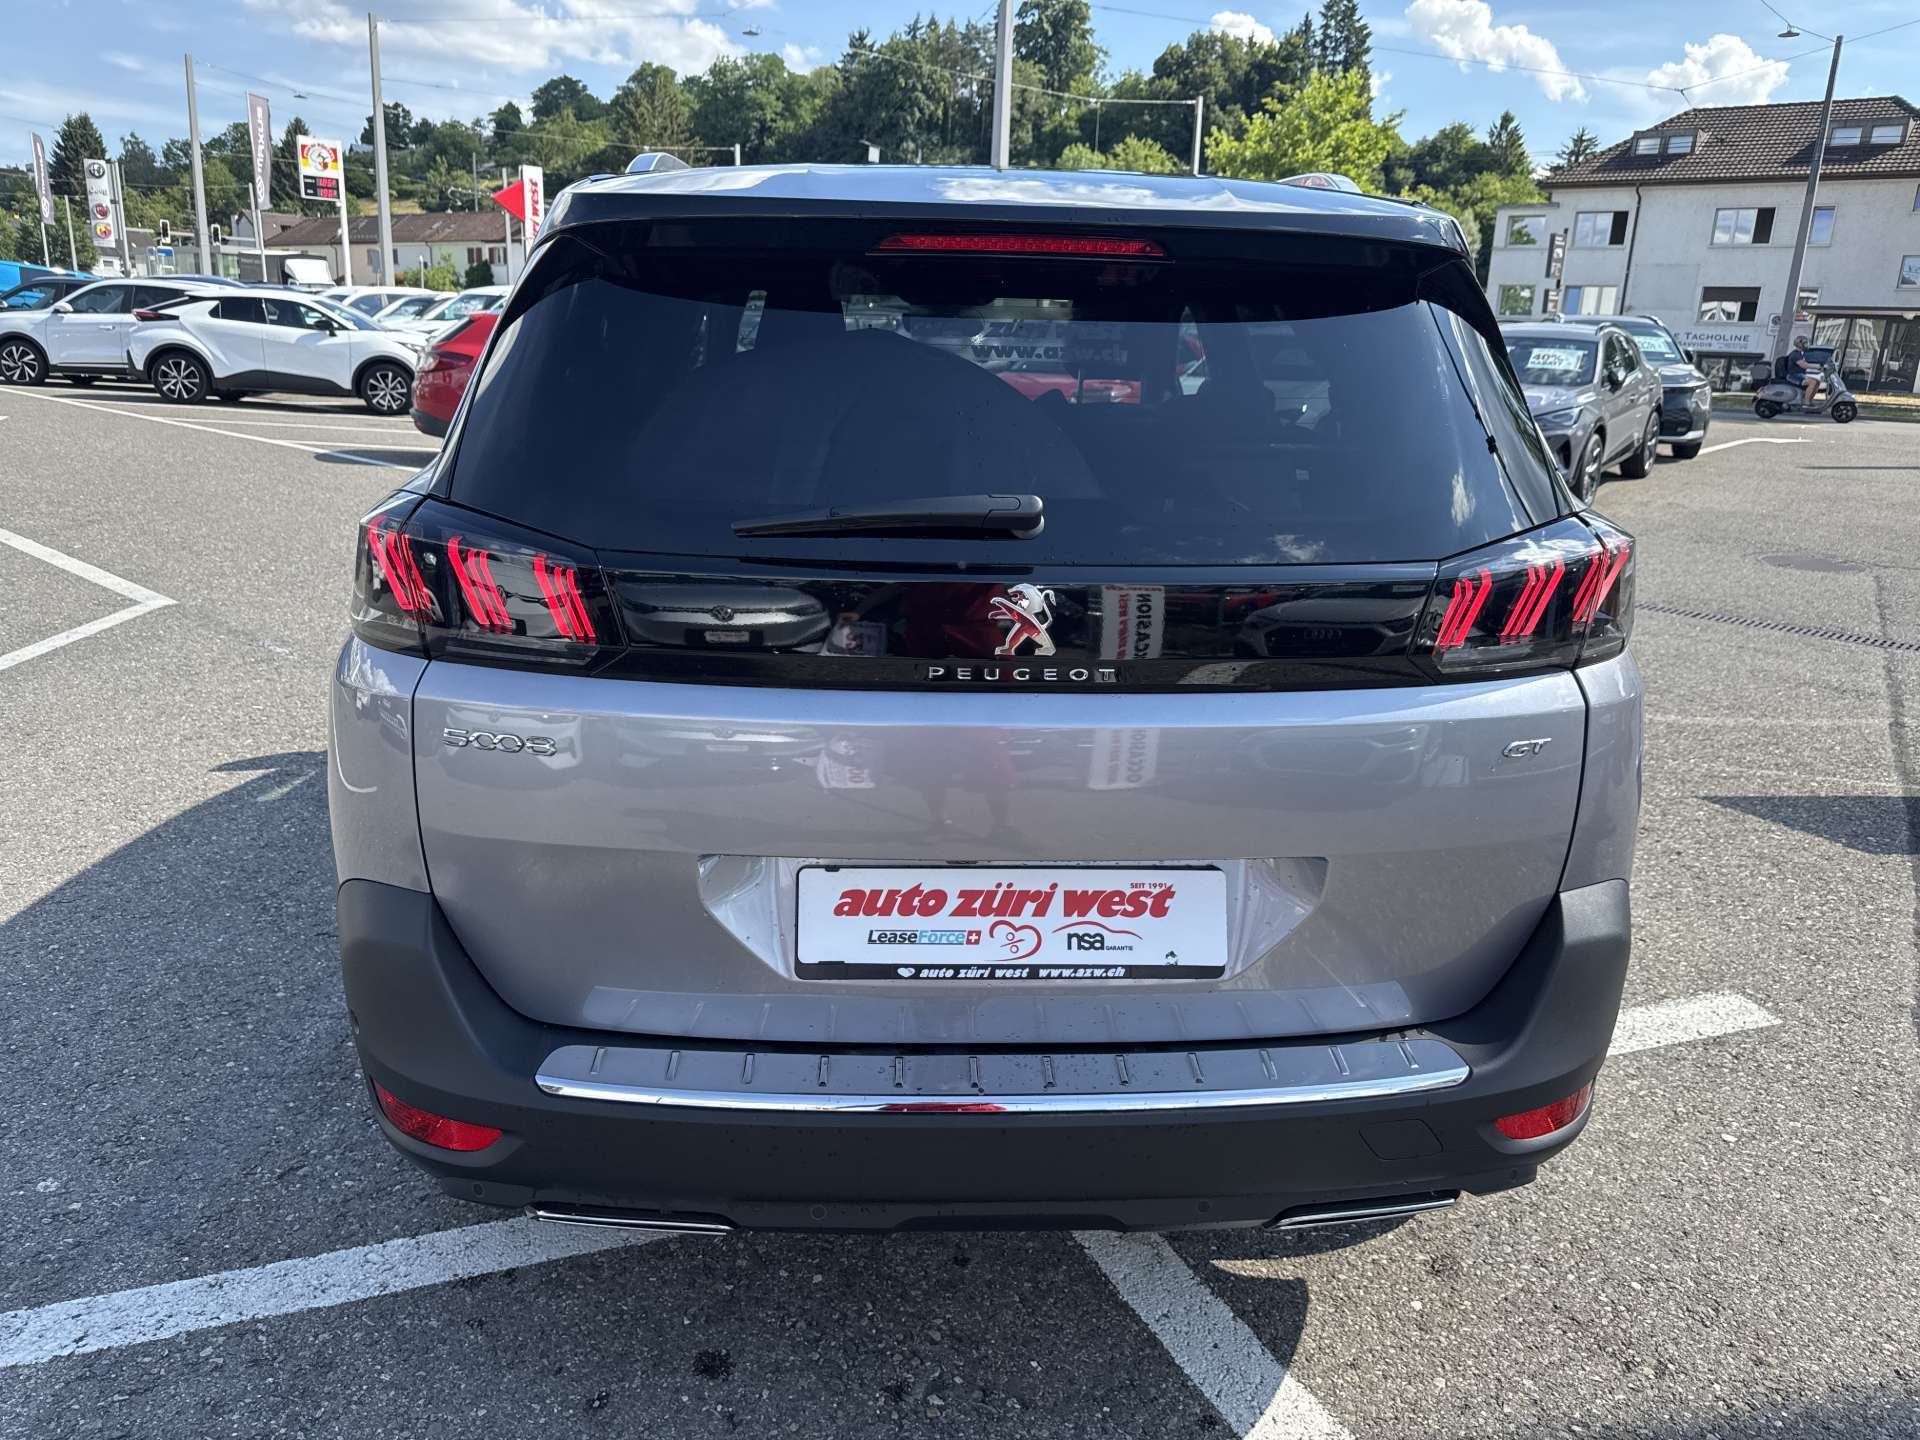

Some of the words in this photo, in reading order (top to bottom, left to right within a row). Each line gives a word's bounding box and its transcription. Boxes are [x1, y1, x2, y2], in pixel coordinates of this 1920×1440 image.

[1685, 332, 1751, 343] TACHOLINE
[928, 666, 1116, 682] PEUGEOT
[440, 728, 557, 757] 5008
[1502, 737, 1552, 757] GT
[832, 882, 948, 917] auto
[949, 882, 1058, 917] züri
[1063, 884, 1176, 918] west
[867, 930, 966, 945] LeaseForce
[1067, 933, 1105, 951] nsa
[919, 968, 954, 978] auto
[957, 966, 991, 978] züri
[995, 967, 1029, 978] west
[1038, 967, 1127, 978] www.azw.ch
